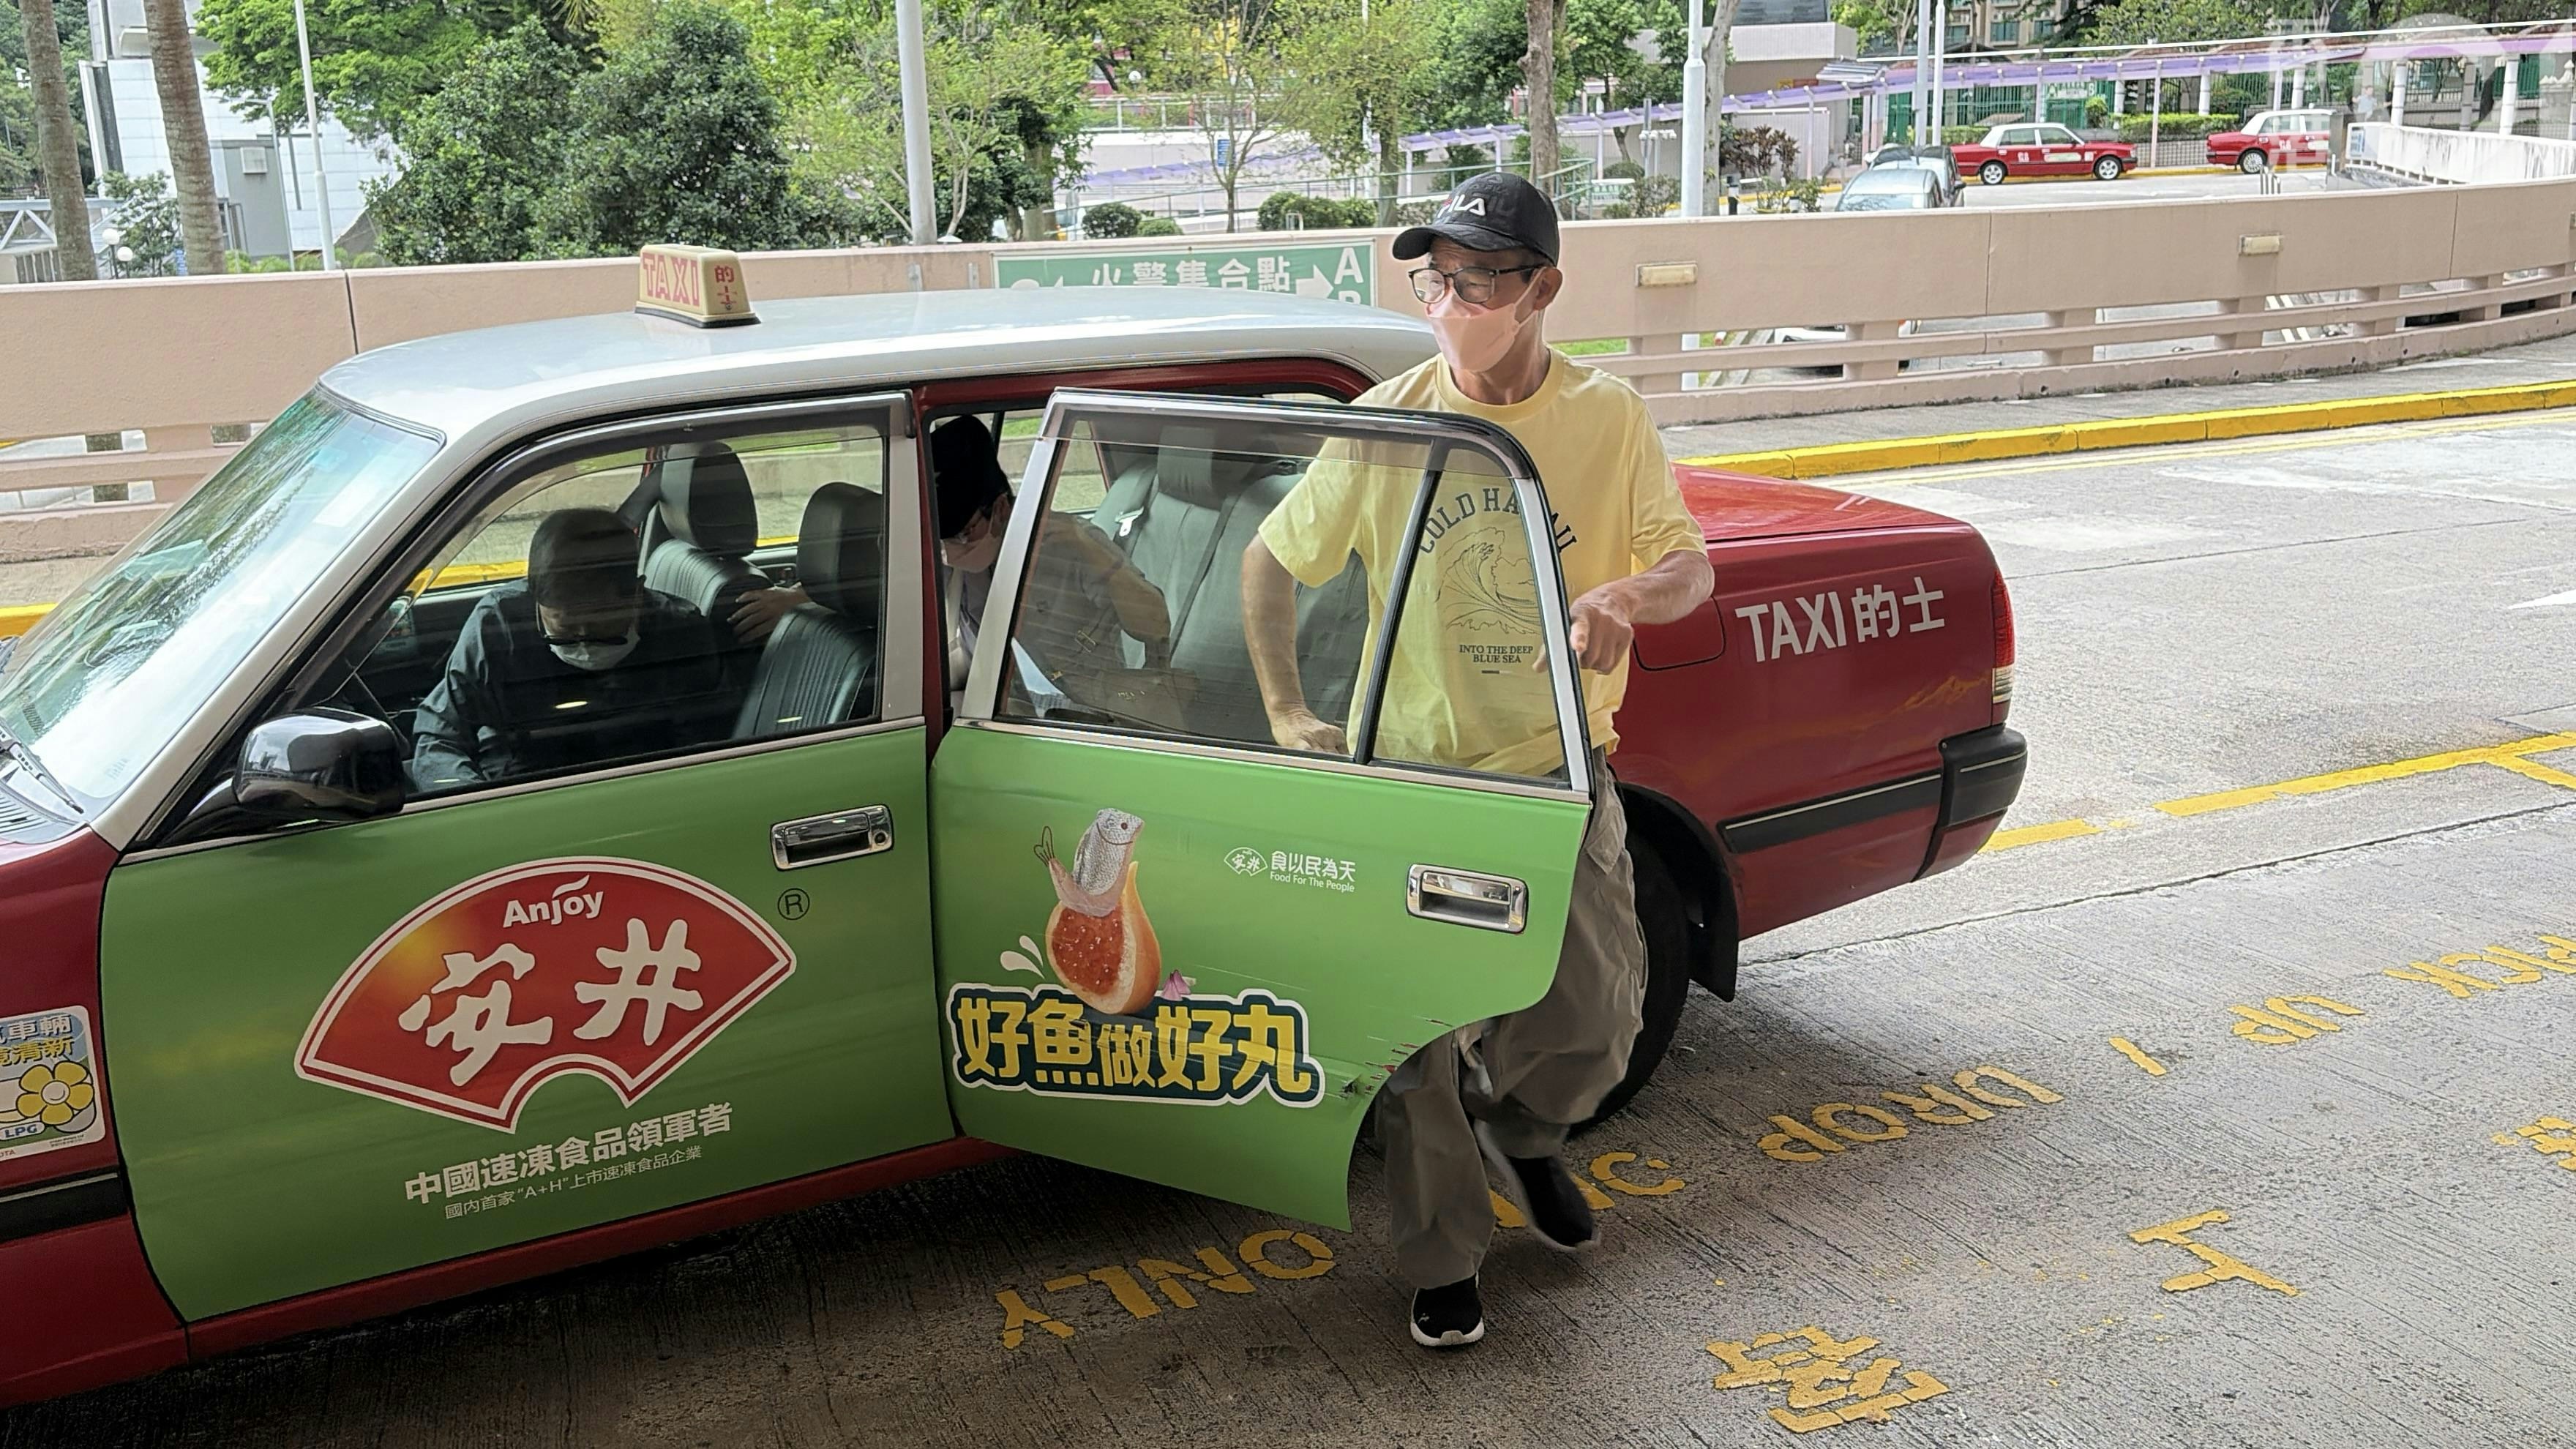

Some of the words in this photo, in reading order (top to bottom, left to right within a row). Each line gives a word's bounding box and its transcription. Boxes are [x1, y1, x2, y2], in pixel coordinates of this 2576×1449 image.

[642, 252, 700, 307] TAXI
[714, 265, 738, 304] 的士
[1334, 247, 1363, 284] A
[1735, 591, 1847, 662] TAXI
[1851, 577, 1946, 643] 的士
[1459, 645, 1484, 654] INTO
[1486, 645, 1508, 654] THE
[1509, 646, 1533, 654] DEEP
[1473, 654, 1500, 663] BLUE
[1502, 655, 1521, 663] SEA
[1270, 871, 1291, 883] Food
[1293, 874, 1306, 885] For
[1308, 877, 1324, 888] The
[1326, 880, 1355, 893] People
[1271, 850, 1355, 882] 食以民為天
[502, 875, 604, 928] Anjoy
[398, 918, 704, 1087] 安井
[2228, 994, 2364, 1045] UP
[0, 1016, 72, 1044] 車輛
[957, 995, 1312, 1095] 好魚做好丸
[4, 1124, 37, 1138] LPG
[1757, 1065, 2064, 1163] DROP
[404, 1101, 733, 1205] 中國速凍食品領軍者
[995, 1229, 1336, 1349] ONLY
